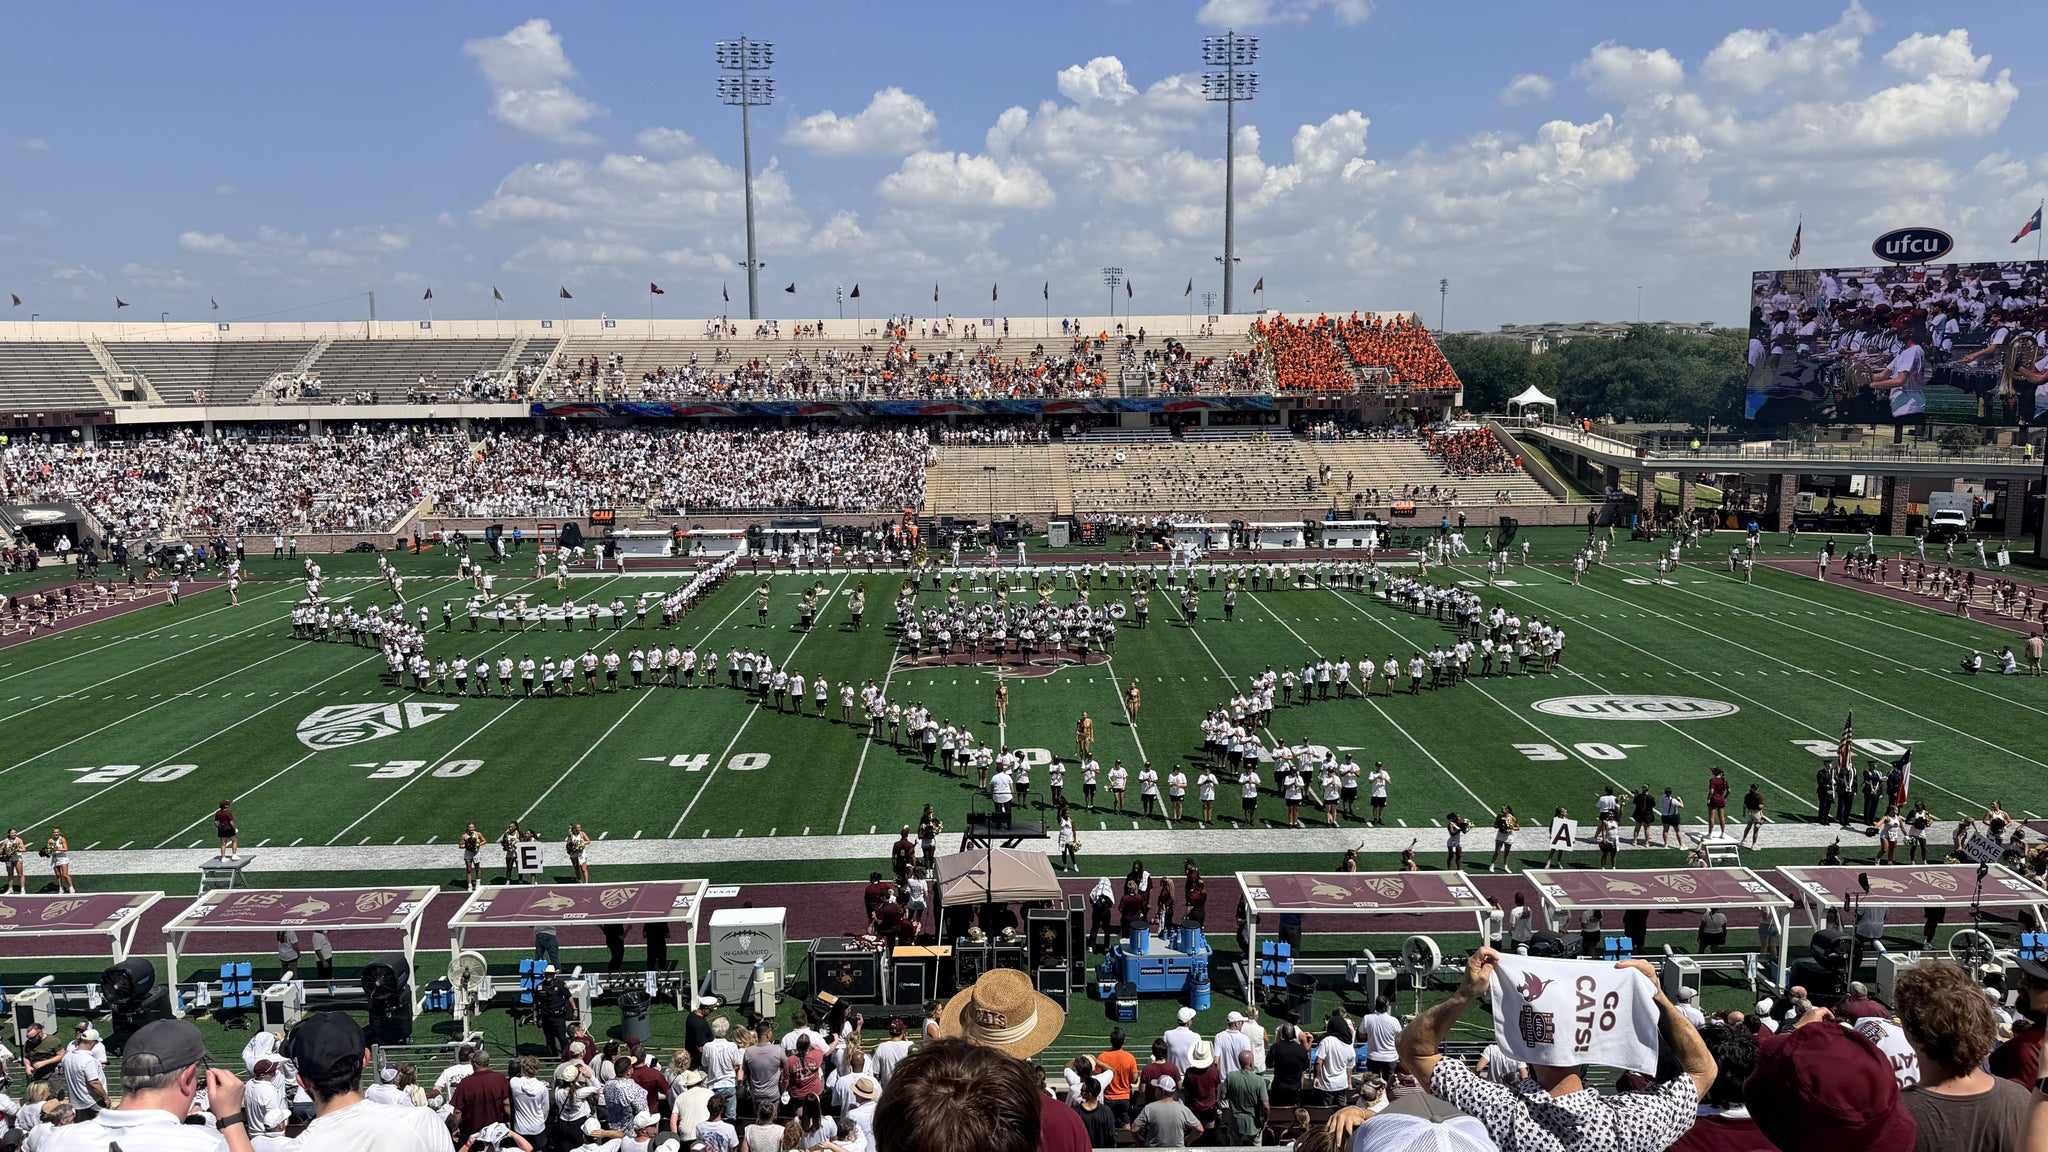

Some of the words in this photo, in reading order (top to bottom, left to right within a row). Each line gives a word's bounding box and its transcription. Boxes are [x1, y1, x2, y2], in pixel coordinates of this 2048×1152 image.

[1886, 234, 1938, 254] ufcu
[592, 511, 613, 520] CW
[1191, 546, 1198, 556] T
[1567, 699, 1707, 714] ufcu
[1512, 743, 1627, 761] 30
[367, 759, 485, 778] 30
[668, 753, 771, 772] 40
[72, 764, 199, 783] 20
[1551, 823, 1571, 847] A
[1970, 835, 2001, 858] MAKE
[521, 846, 538, 869] E
[1574, 975, 1597, 1053] CATS!
[1600, 991, 1619, 1032] GO
[1524, 1006, 1535, 1047] STADIUM
[1535, 1018, 1543, 1037] ufcu
